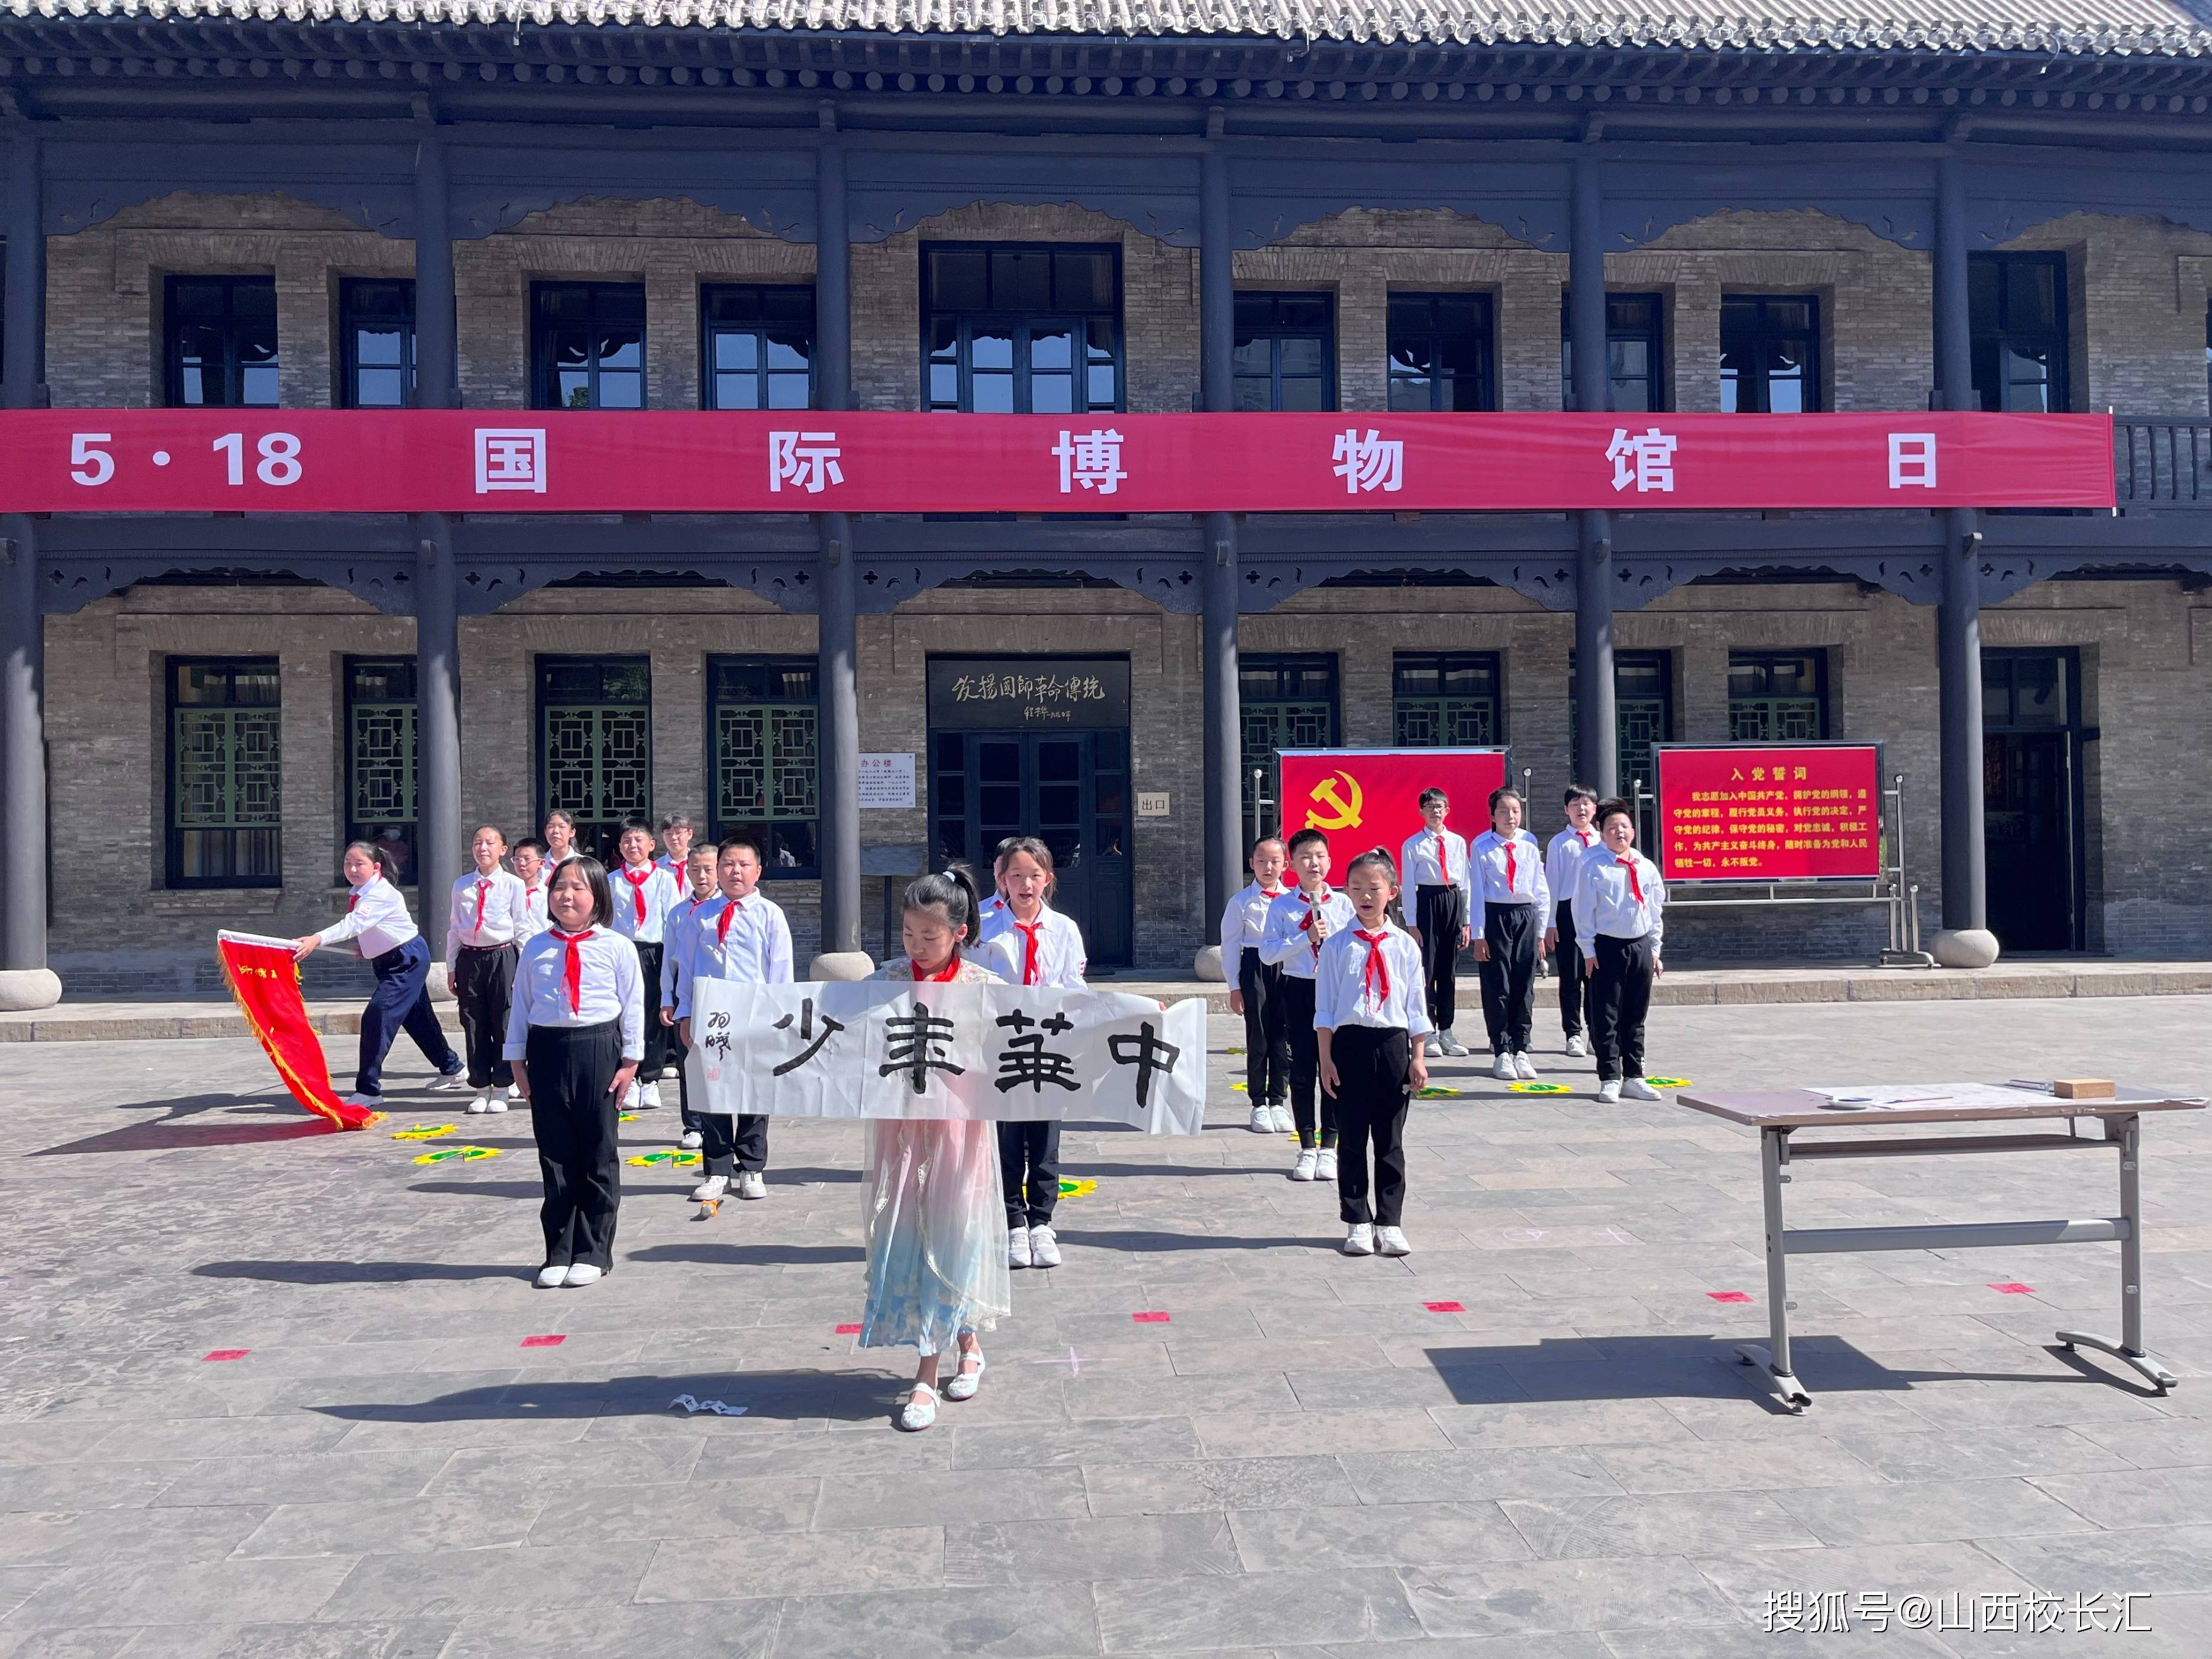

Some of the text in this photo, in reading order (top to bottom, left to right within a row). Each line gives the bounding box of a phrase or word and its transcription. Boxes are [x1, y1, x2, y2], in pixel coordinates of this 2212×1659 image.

[474, 428, 1937, 495] 国际博物馆日
[1730, 766, 1807, 781] 入党誓词
[1142, 799, 1165, 811] 出口
